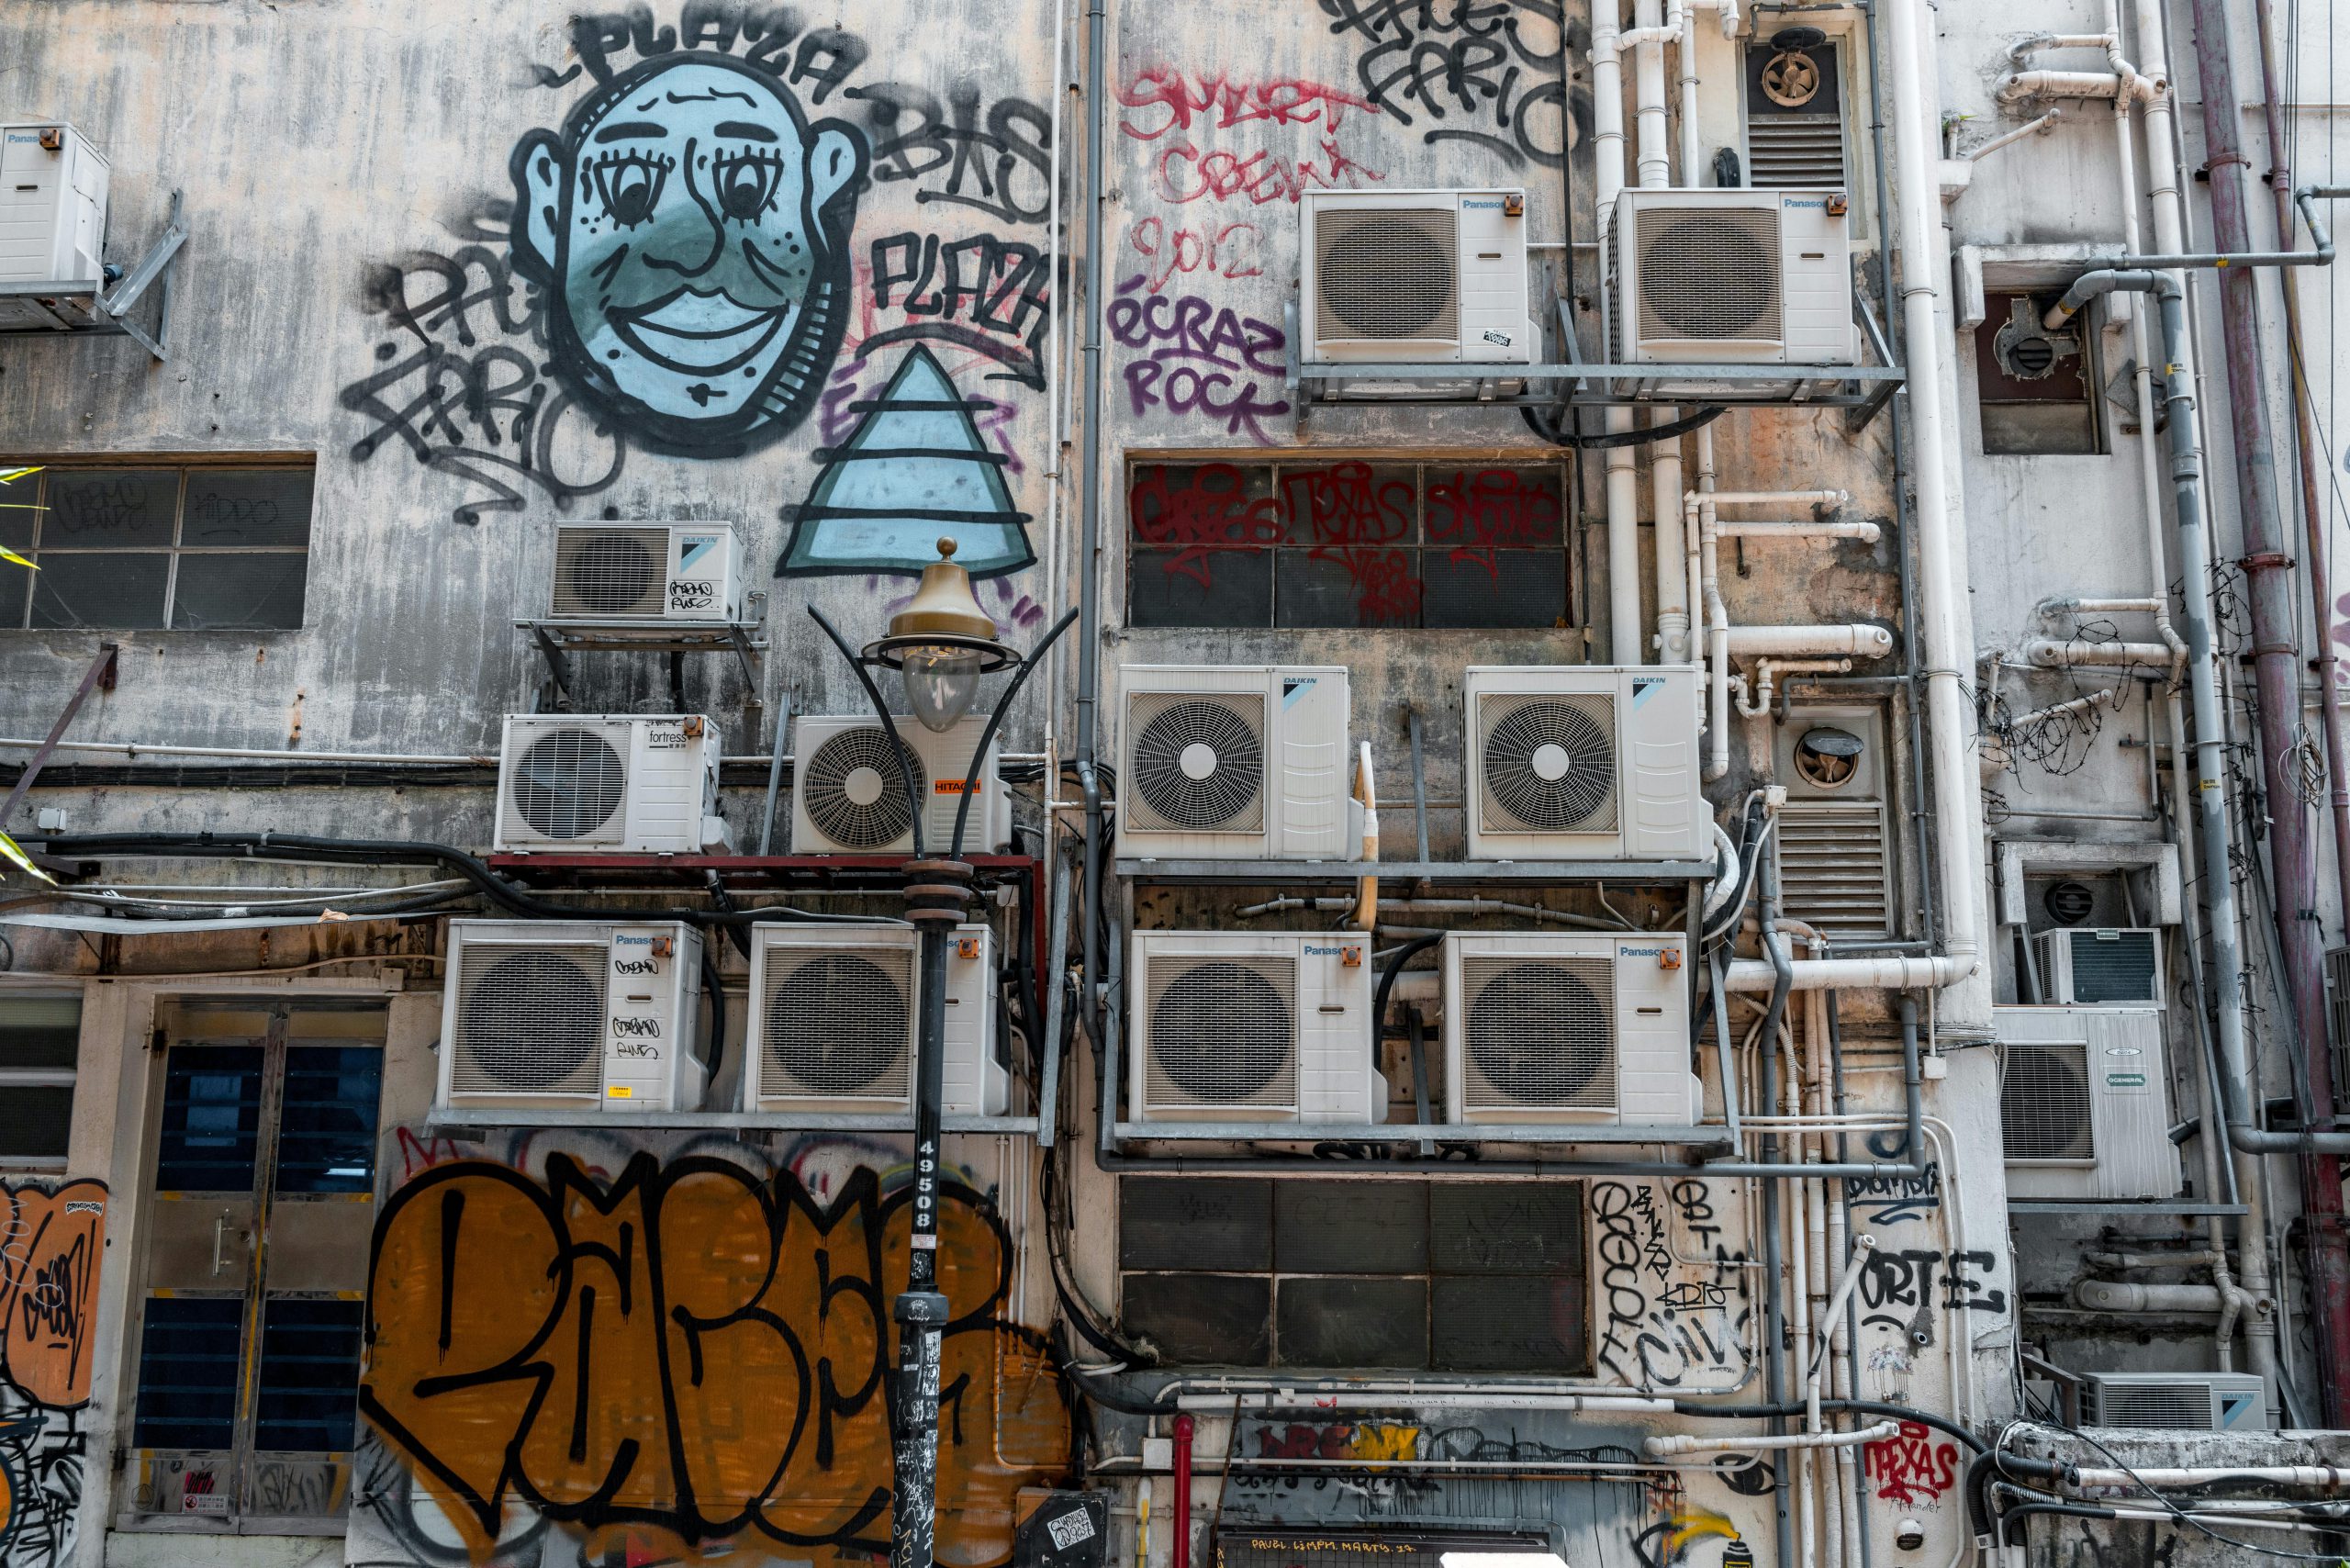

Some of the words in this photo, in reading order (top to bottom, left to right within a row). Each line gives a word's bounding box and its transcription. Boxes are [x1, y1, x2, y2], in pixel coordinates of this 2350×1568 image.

[569, 0, 870, 106] PLAZA
[8, 134, 39, 142] Panas
[1124, 359, 1290, 436] ROCK
[650, 731, 687, 743] fortress
[916, 1140, 934, 1227] 49508
